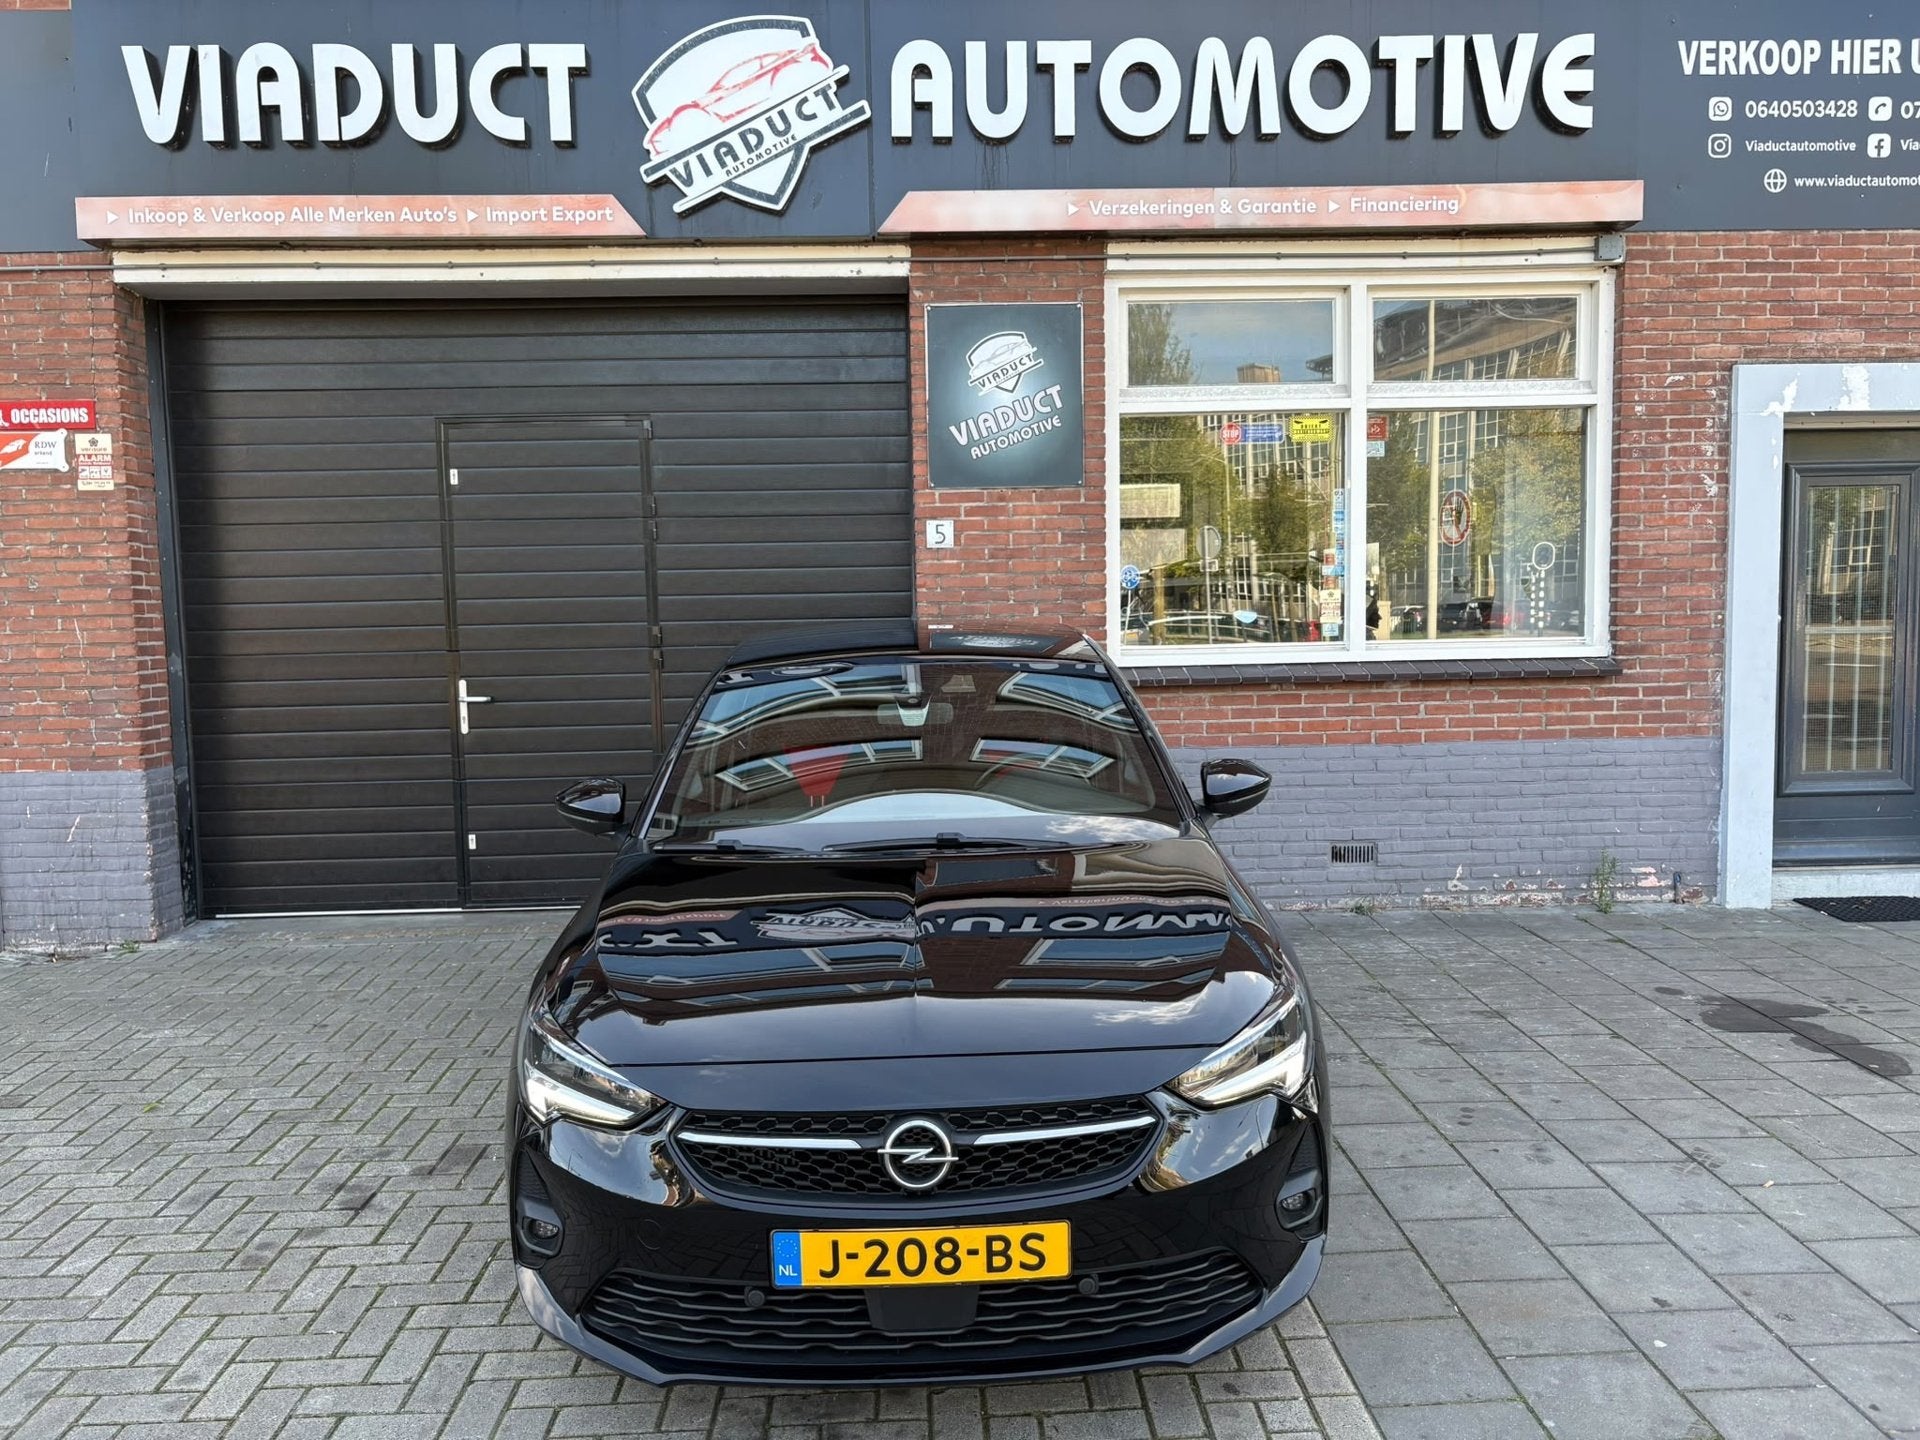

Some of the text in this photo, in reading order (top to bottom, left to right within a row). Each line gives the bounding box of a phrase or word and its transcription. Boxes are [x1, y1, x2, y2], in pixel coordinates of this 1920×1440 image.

[1678, 39, 1821, 76] VERKOOP
[1830, 38, 1902, 75] HIER
[121, 42, 587, 145] VIADUCT
[891, 33, 1595, 138] AUTOMOTIVE
[1745, 99, 1858, 118] 0640503428
[669, 83, 837, 188] VIADUCT
[1745, 139, 1857, 153] Viaductautomotive
[725, 134, 798, 177] AUTOMOTIVE
[486, 205, 614, 223] Import Export
[1090, 197, 1317, 218] Verzekeringen & Garantie
[1350, 195, 1460, 214] Financiering
[128, 206, 458, 225] Inkoop & Verkoop Alle Merken Auto's
[978, 353, 1033, 387] VIADUCT
[11, 408, 88, 423] OCCASIONS
[949, 384, 1064, 446] VIADUCT
[970, 415, 1062, 460] AUTOMOTIVE
[79, 454, 111, 462] ALARM
[935, 524, 946, 544] 5
[819, 1232, 1047, 1279] J-208-BS
[779, 1264, 798, 1276] NL
